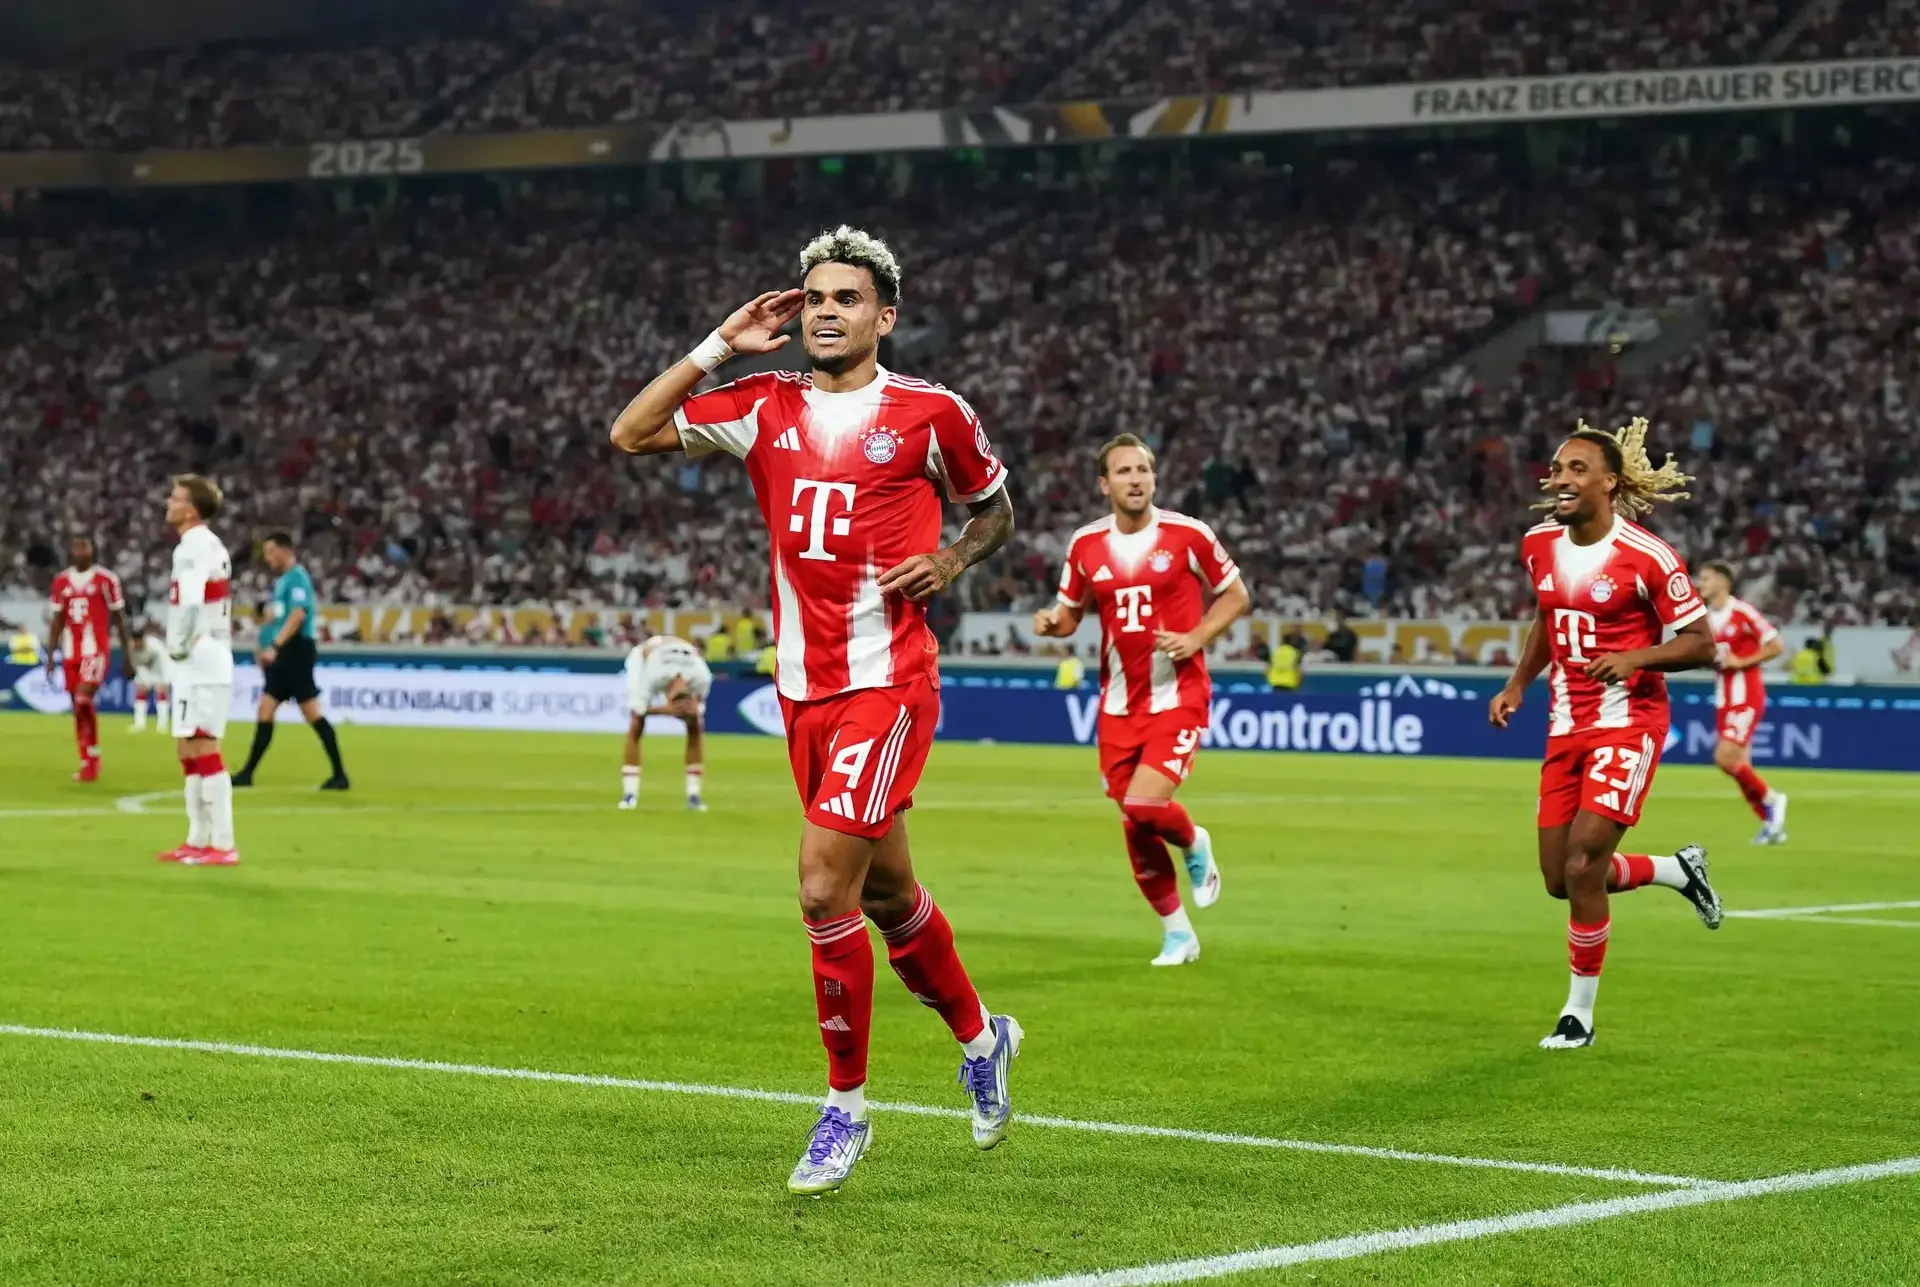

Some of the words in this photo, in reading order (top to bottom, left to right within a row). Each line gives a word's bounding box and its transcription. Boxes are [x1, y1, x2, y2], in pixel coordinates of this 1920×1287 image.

[1413, 82, 1519, 117] FRANZ
[1528, 69, 1773, 111] BECKENBAUER
[1783, 62, 1920, 99] SUPERC
[308, 139, 424, 177] 2025
[788, 478, 857, 562] T
[1115, 584, 1153, 634] T
[1554, 607, 1597, 665] T
[177, 700, 188, 722] 7
[329, 685, 495, 714] BECKENBAUER
[502, 690, 616, 717] SUPERCUP
[1201, 697, 1422, 755] Kontrolle
[1589, 746, 1642, 791] 23
